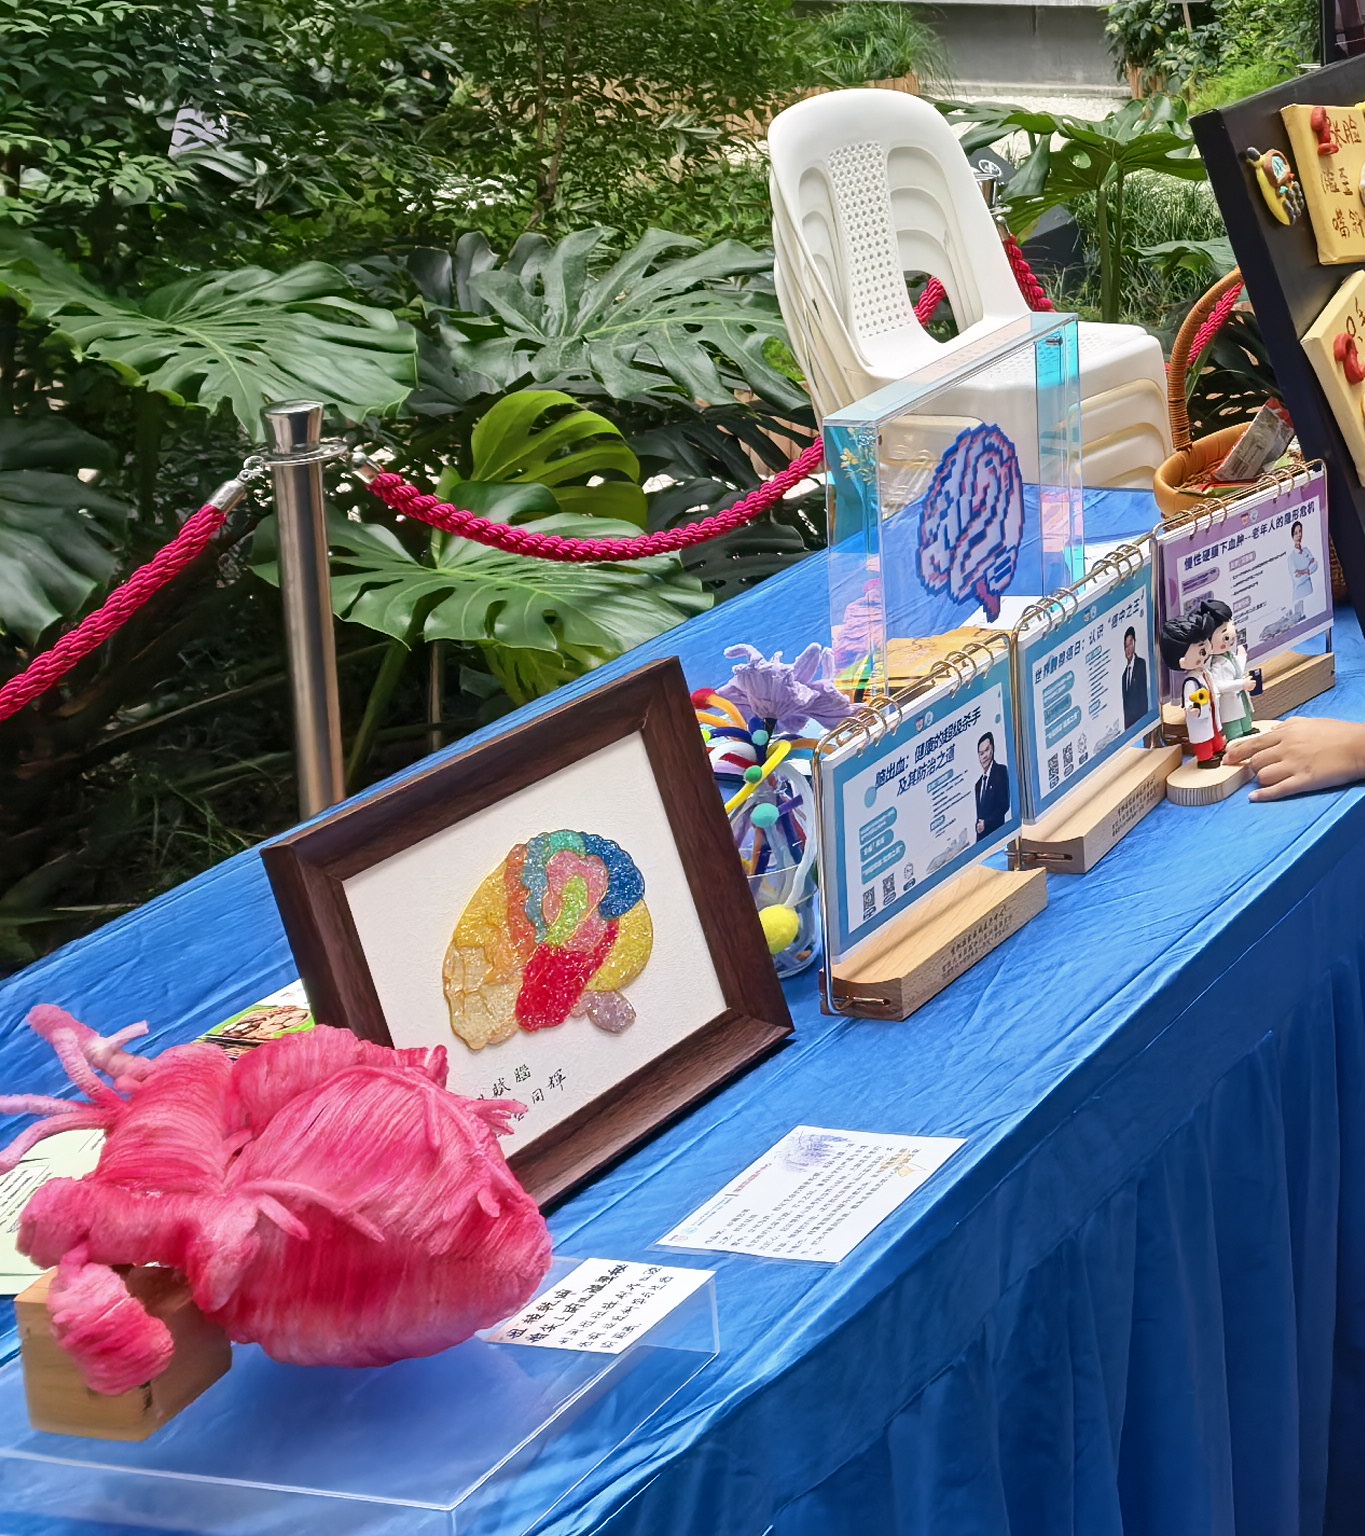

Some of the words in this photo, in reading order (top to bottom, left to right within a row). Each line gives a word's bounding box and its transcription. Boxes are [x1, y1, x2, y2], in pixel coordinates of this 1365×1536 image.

[897, 743, 955, 797] 及其防治之道
